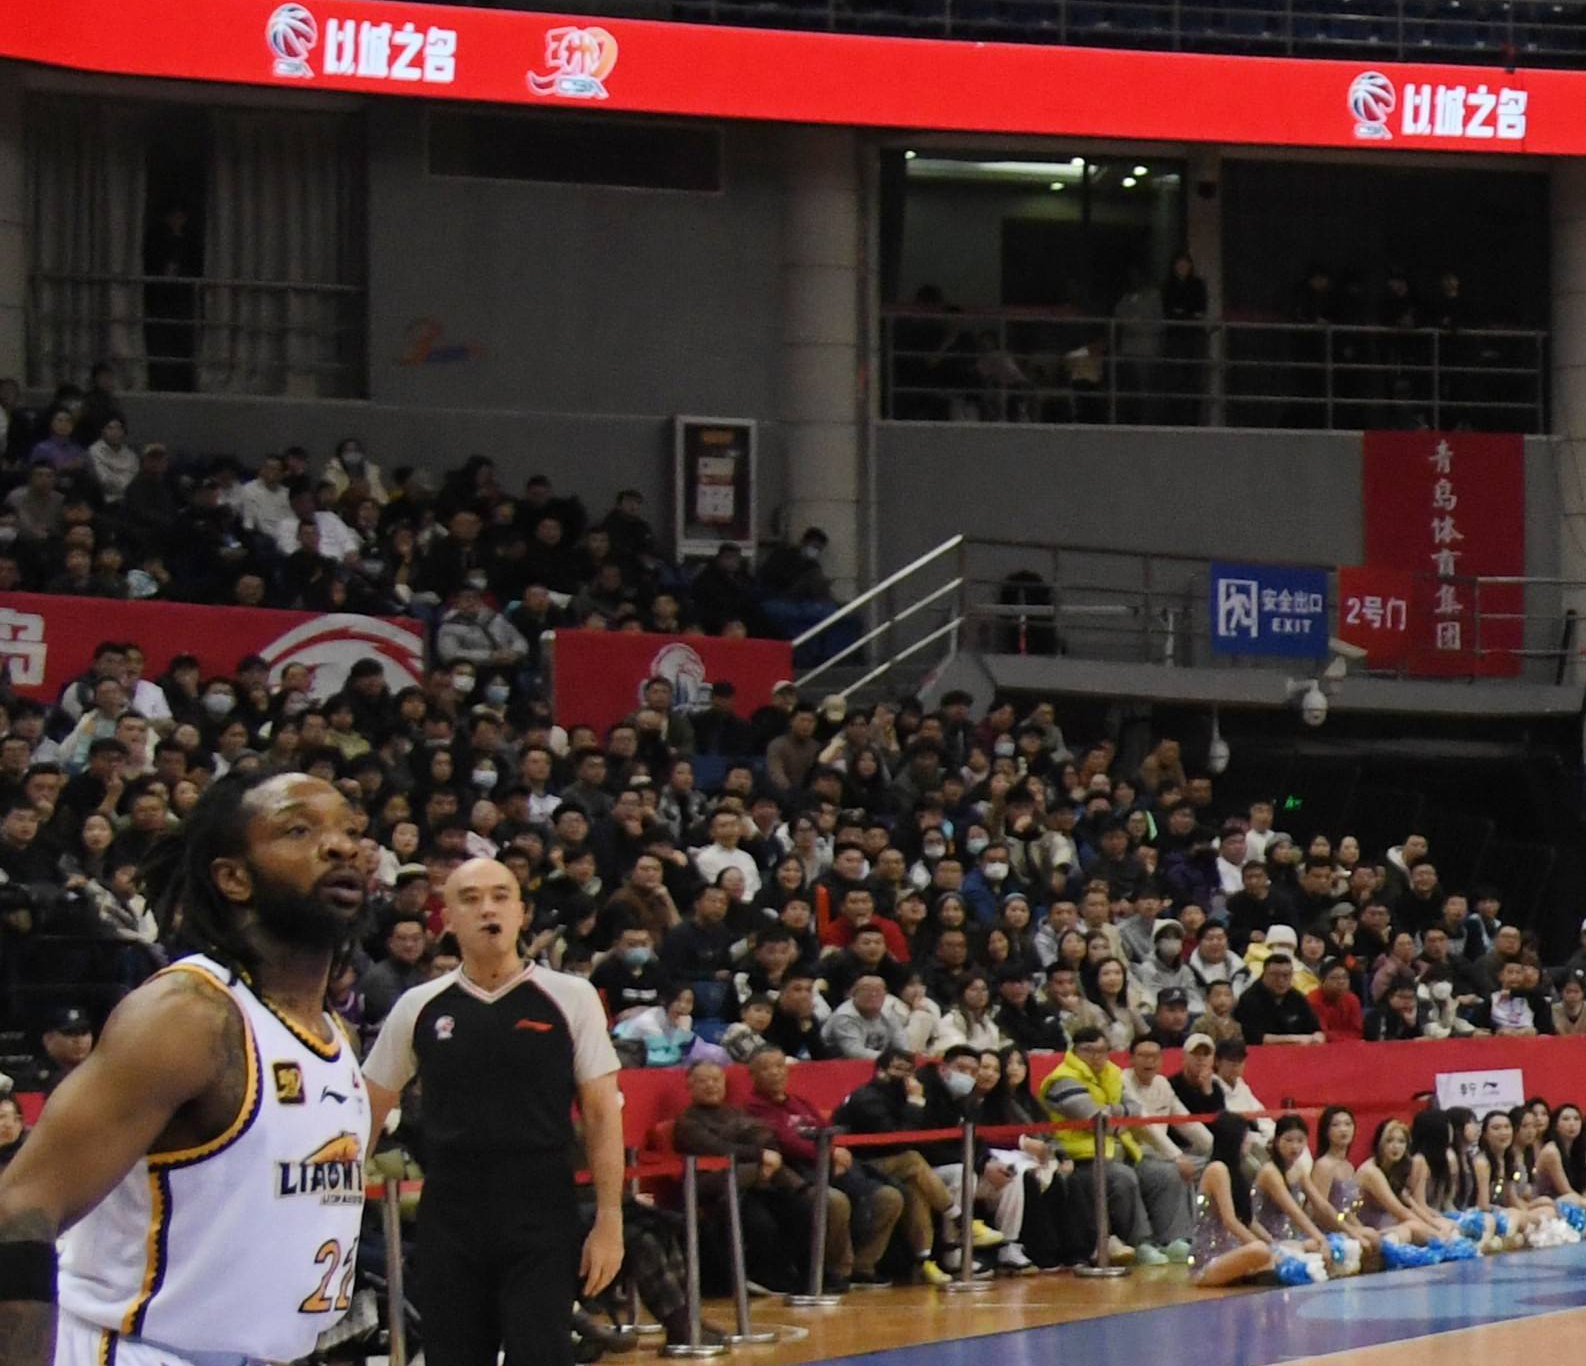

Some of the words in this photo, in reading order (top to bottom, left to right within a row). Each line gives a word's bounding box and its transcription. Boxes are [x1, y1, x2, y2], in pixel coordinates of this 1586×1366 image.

[325, 17, 457, 83] 以城之名
[1403, 83, 1528, 140] 以城之名
[1260, 588, 1324, 615] 安全出口
[1346, 596, 1408, 631] 2号门
[1271, 617, 1313, 634] EXIT
